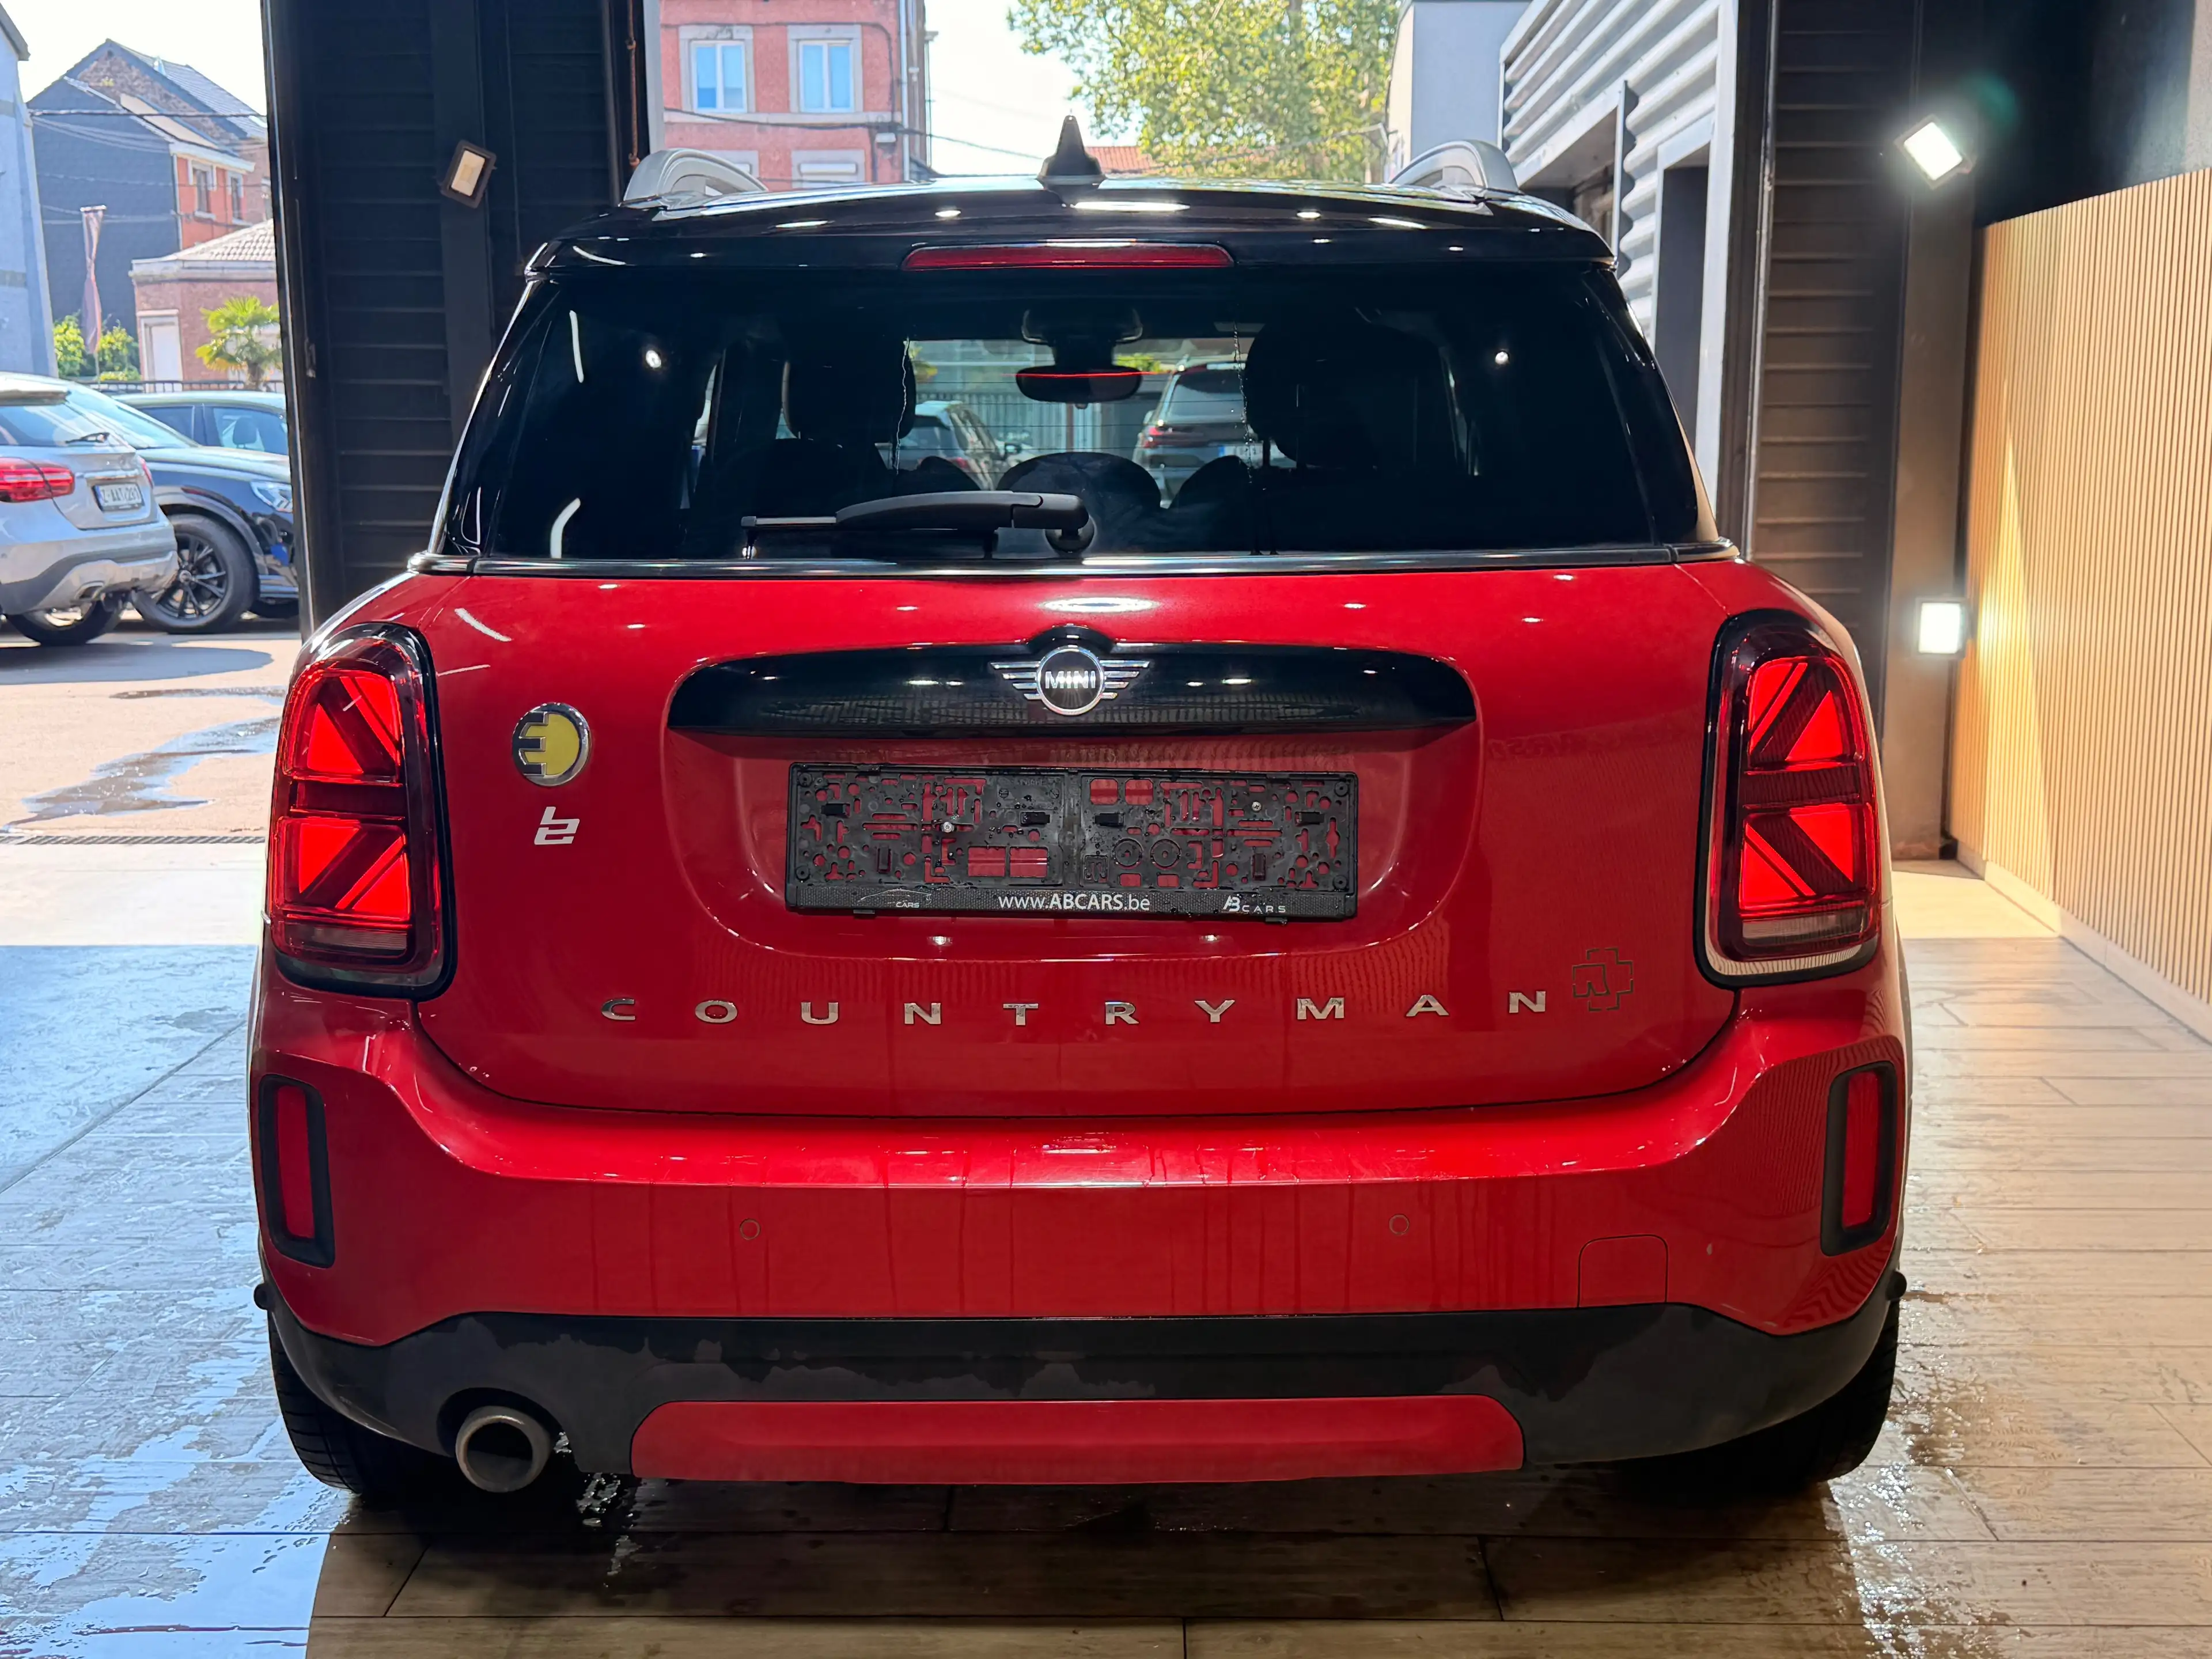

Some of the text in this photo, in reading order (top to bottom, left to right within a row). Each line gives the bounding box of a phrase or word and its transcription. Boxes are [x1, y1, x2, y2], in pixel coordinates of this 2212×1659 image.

[1045, 671, 1096, 689] MINI
[998, 893, 1150, 911] www.ABCARS.be
[601, 990, 1547, 1026] COUNTRYMAN
